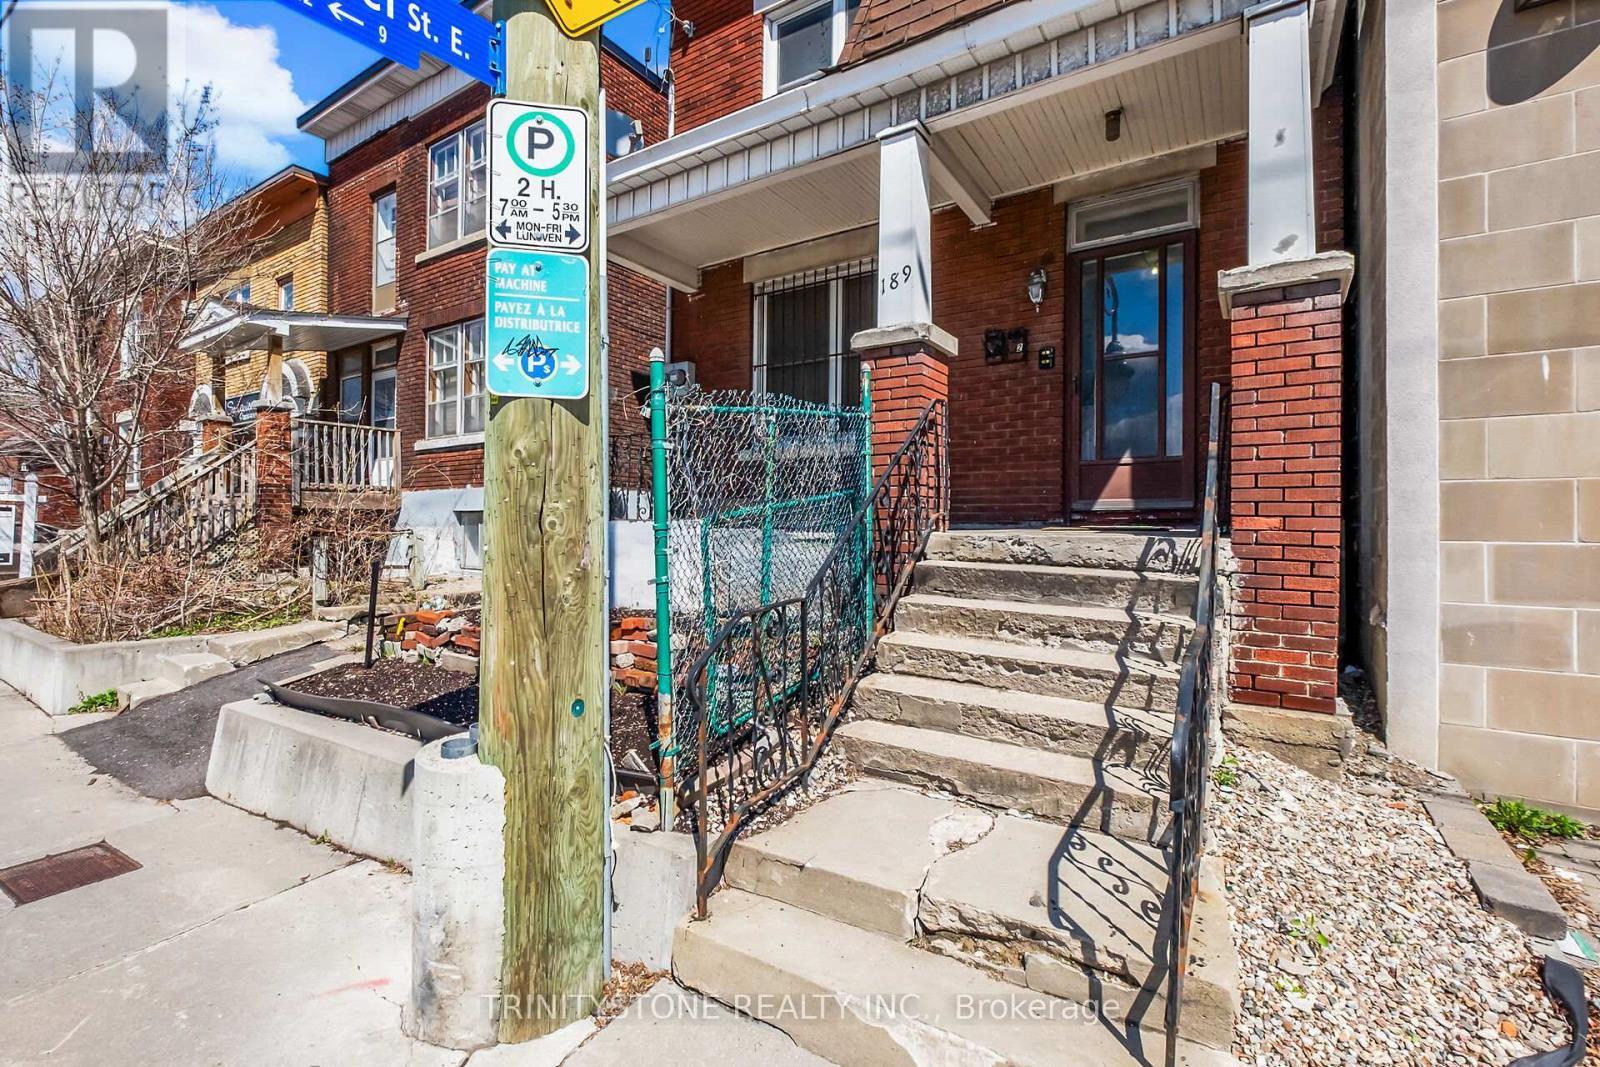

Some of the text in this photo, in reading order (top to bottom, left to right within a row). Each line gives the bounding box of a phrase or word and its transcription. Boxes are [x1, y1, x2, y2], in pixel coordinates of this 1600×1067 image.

[379, 25, 388, 44] 9
[408, 2, 439, 43] St.
[451, 25, 470, 60] E.
[528, 126, 555, 160] P
[517, 177, 561, 200] 2 H.
[516, 221, 562, 233] MON-FRI
[495, 261, 537, 277] PAY AT
[495, 276, 548, 292] MACHINE
[881, 264, 912, 296] 189
[495, 301, 532, 315] PAYEZ
[550, 304, 566, 318] LA
[494, 316, 581, 334] DISTRIBUTRICE
